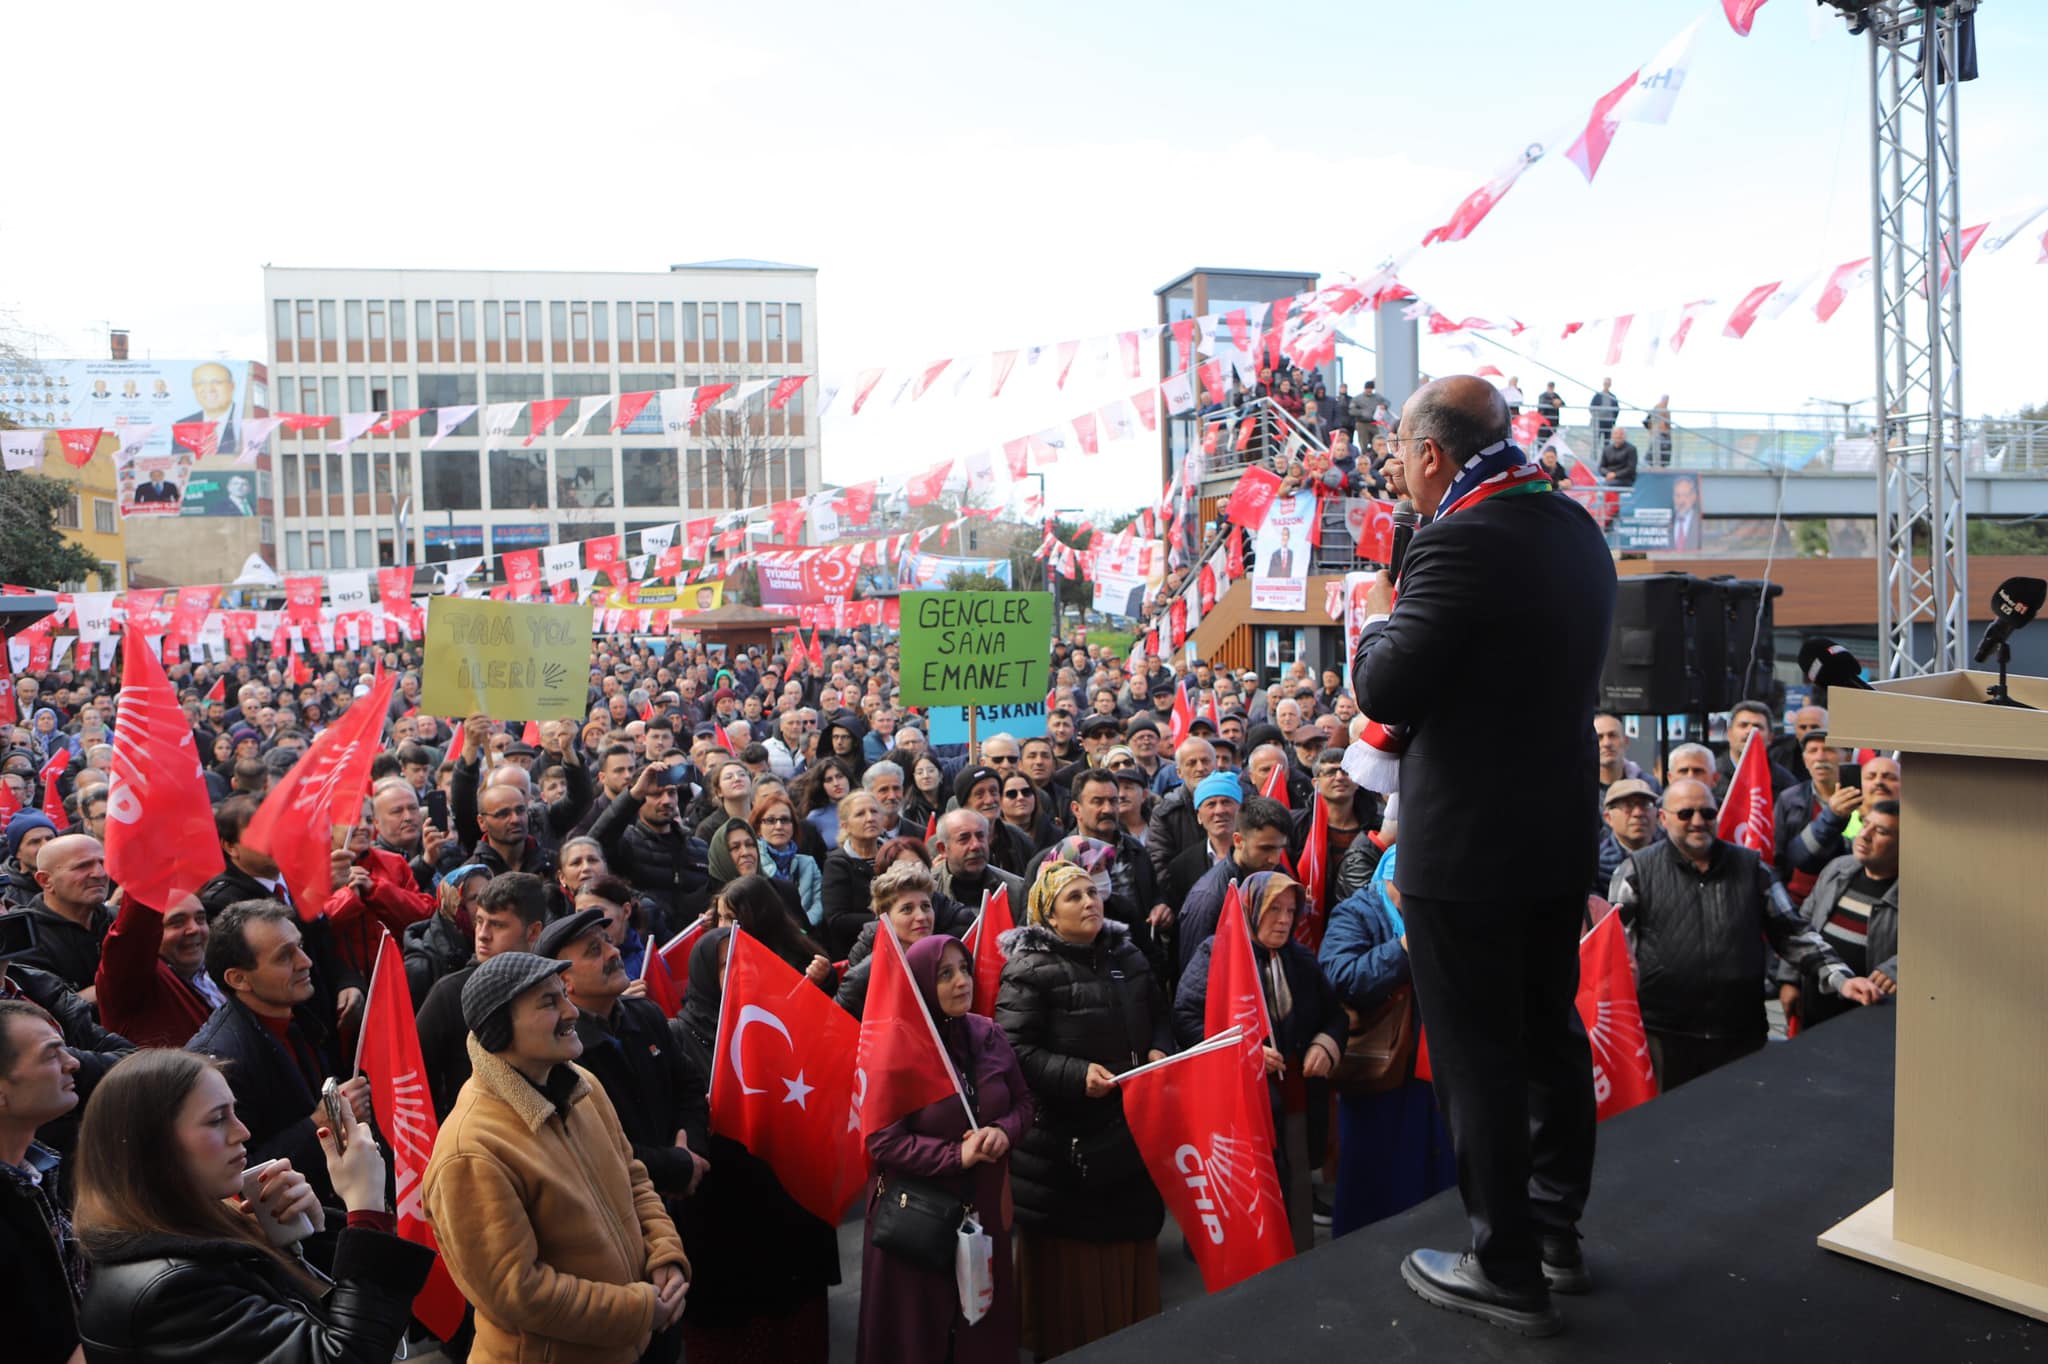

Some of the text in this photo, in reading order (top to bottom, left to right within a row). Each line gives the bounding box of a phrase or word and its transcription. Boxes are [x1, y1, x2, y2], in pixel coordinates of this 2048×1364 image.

[919, 597, 1033, 629] GENÇLER
[443, 612, 577, 648] TAM YOL
[937, 630, 1006, 655] SANA
[457, 657, 537, 690] İLERİ
[922, 659, 1037, 692] EMANET
[1174, 1143, 1225, 1245] CHP
